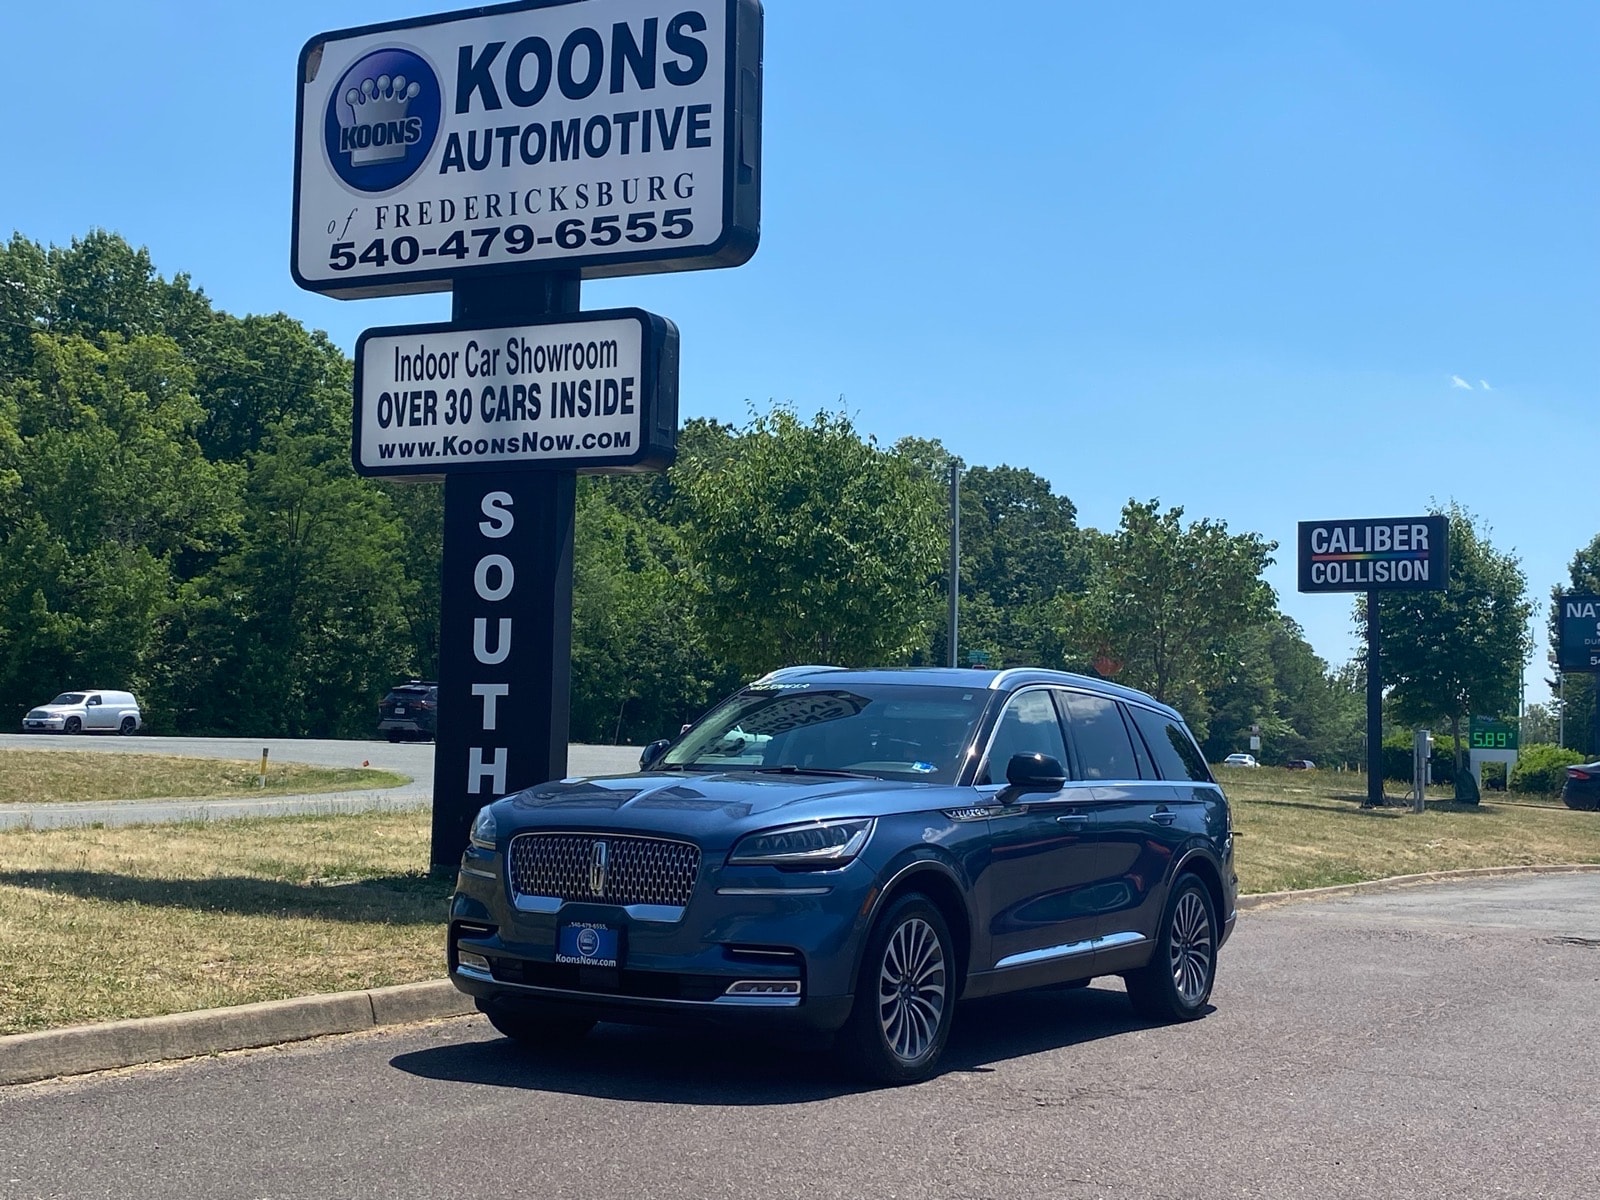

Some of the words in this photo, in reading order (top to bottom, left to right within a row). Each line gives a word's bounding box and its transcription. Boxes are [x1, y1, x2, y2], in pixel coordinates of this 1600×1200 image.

[455, 11, 709, 115] KOONS
[340, 117, 422, 152] KOONS
[439, 104, 712, 175] AUTOMOTIVE
[327, 208, 359, 241] of
[375, 173, 695, 230] FREDERICKSBURG
[328, 208, 694, 271] 540-479-6555
[394, 344, 459, 382] Indoor
[465, 340, 500, 378] Car
[506, 337, 618, 375] Showroom
[377, 390, 437, 429] OVER
[445, 388, 473, 425] 30
[480, 383, 541, 423] CARS
[551, 377, 635, 419] INSIDE
[1311, 524, 1429, 554] CALIBER
[1311, 559, 1429, 584] COLLISION
[467, 491, 515, 795] SOUTH
[555, 953, 617, 967] KoonsNow.com
